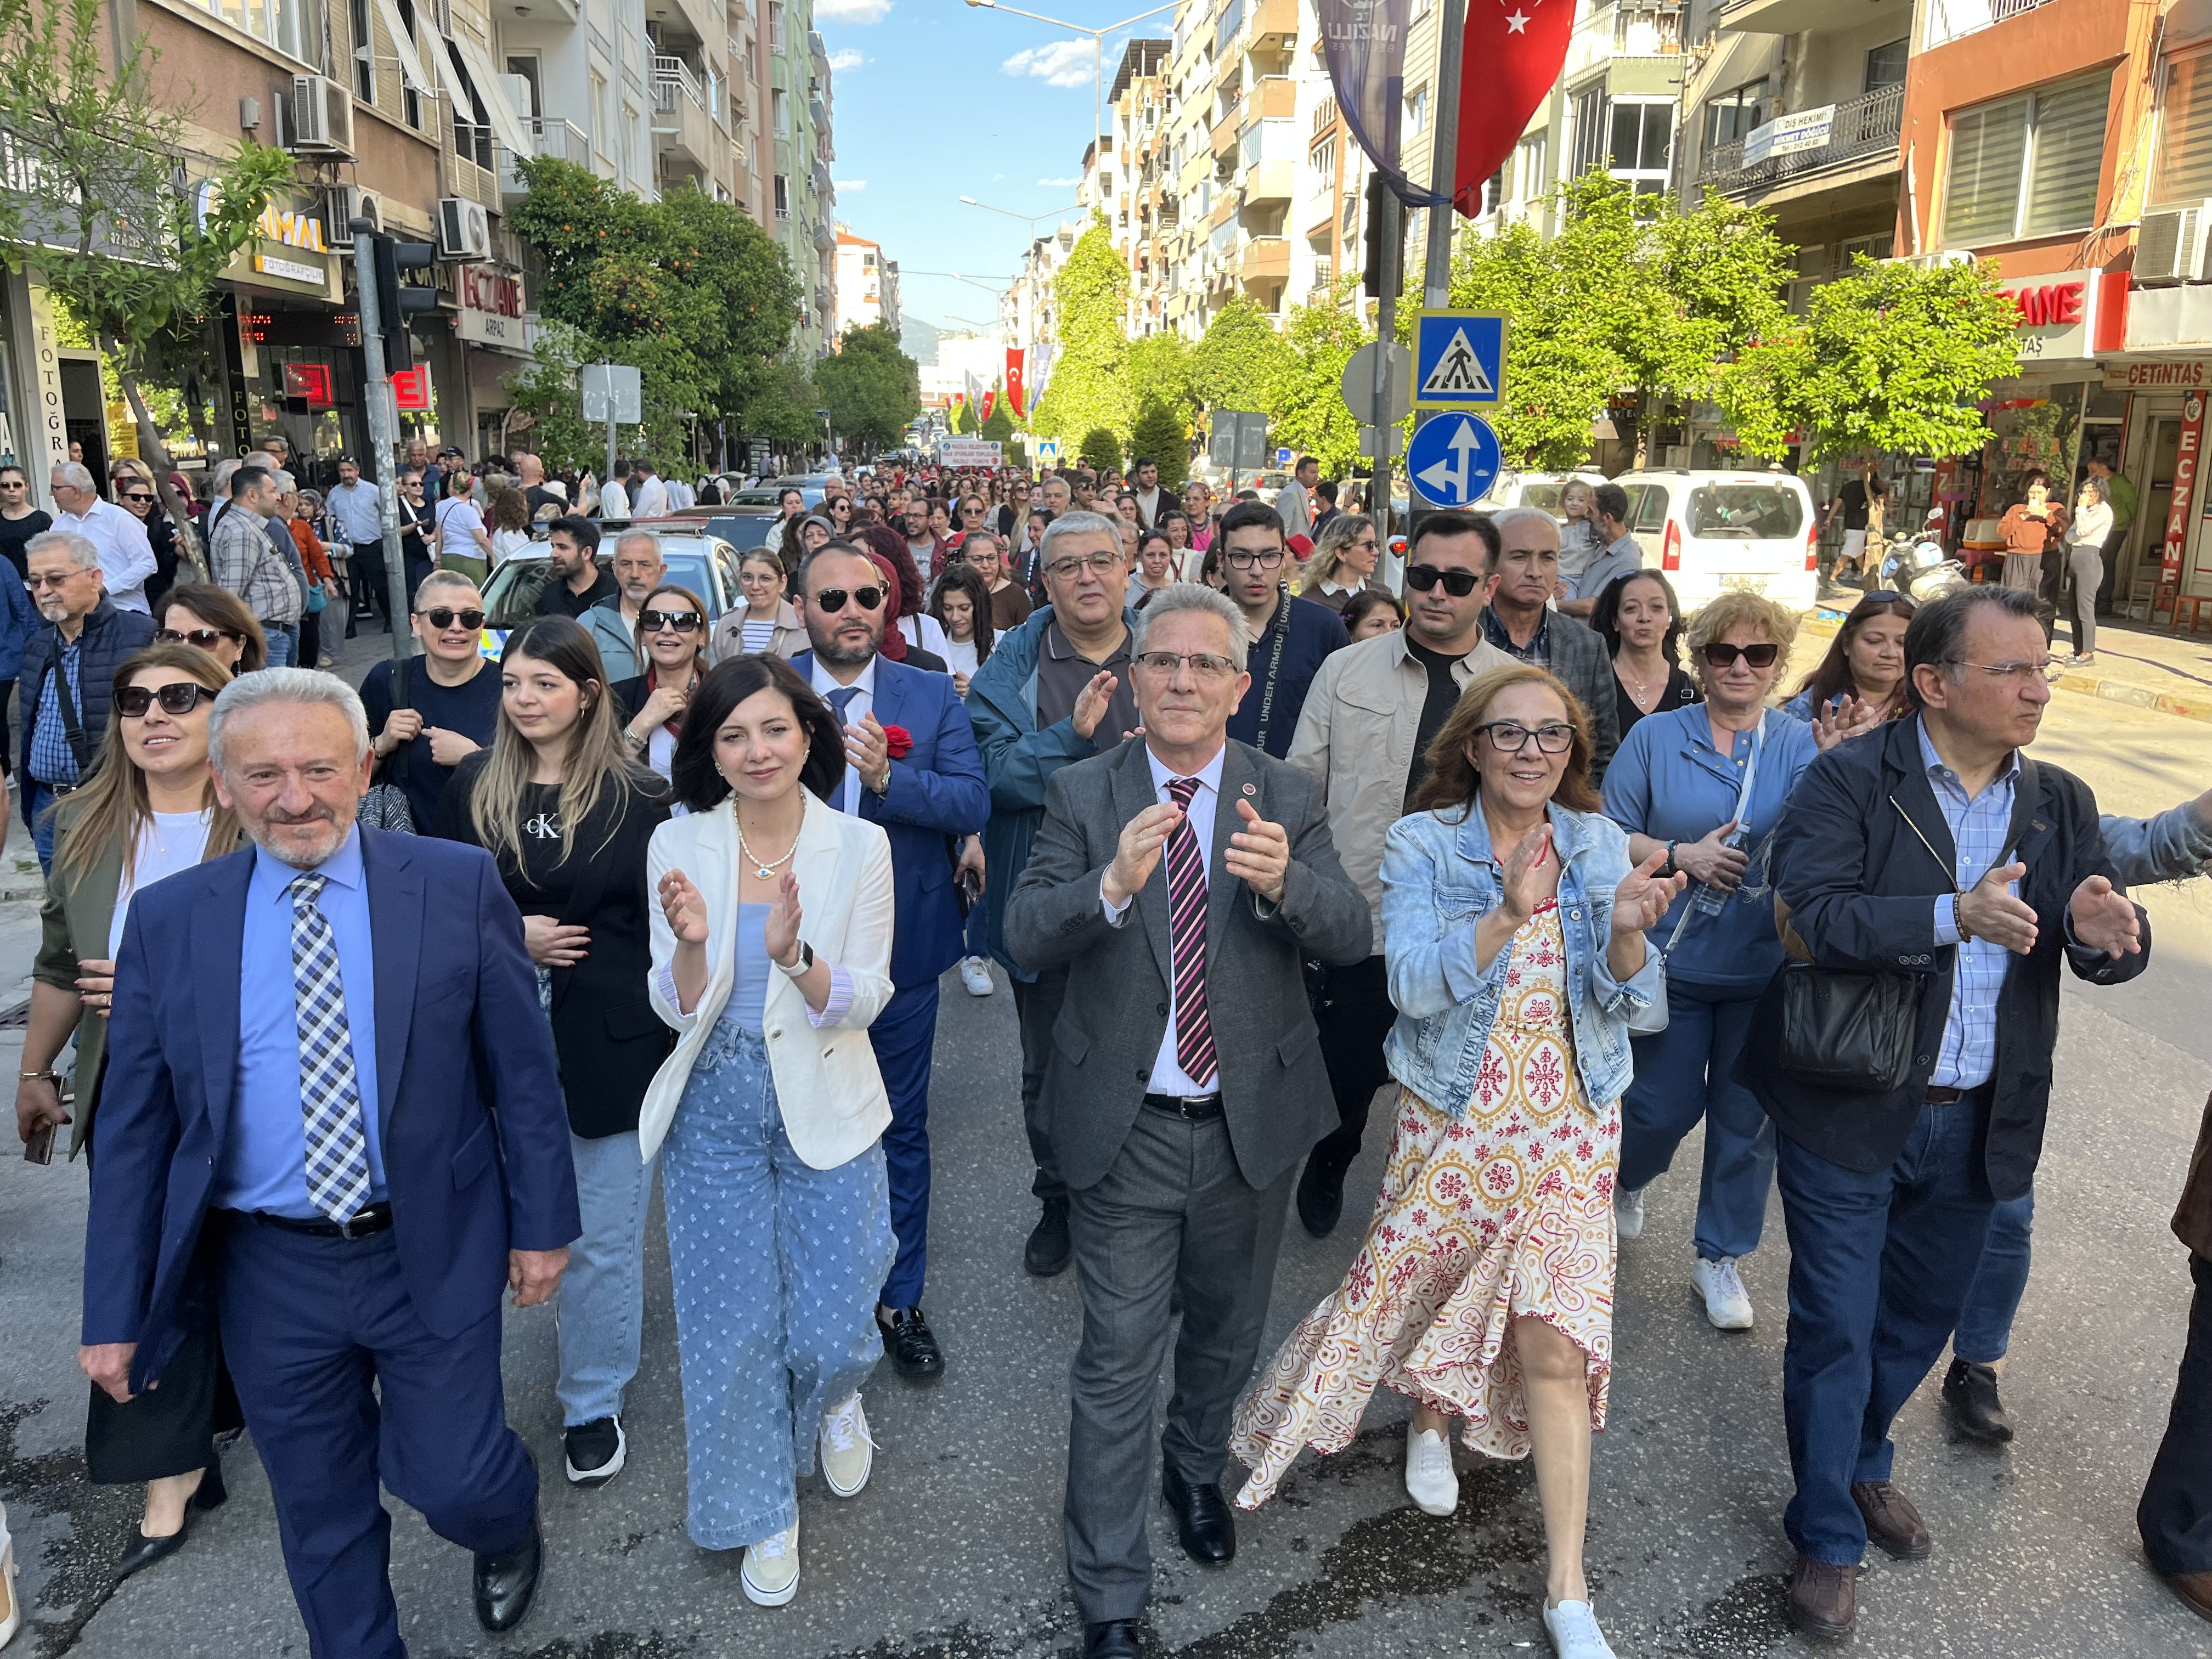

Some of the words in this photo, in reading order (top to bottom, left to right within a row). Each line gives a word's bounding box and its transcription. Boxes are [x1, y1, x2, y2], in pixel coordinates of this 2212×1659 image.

[1785, 119, 1797, 129] DİŞ
[1798, 110, 1825, 126] HEKİMİ
[246, 191, 328, 255] İMAL
[485, 318, 505, 338] ARPAZ
[2020, 337, 2043, 357] TAŞ
[1280, 592, 1291, 623] UNDE
[1260, 680, 1276, 723] UNDER
[1268, 632, 1285, 680] ARMOU
